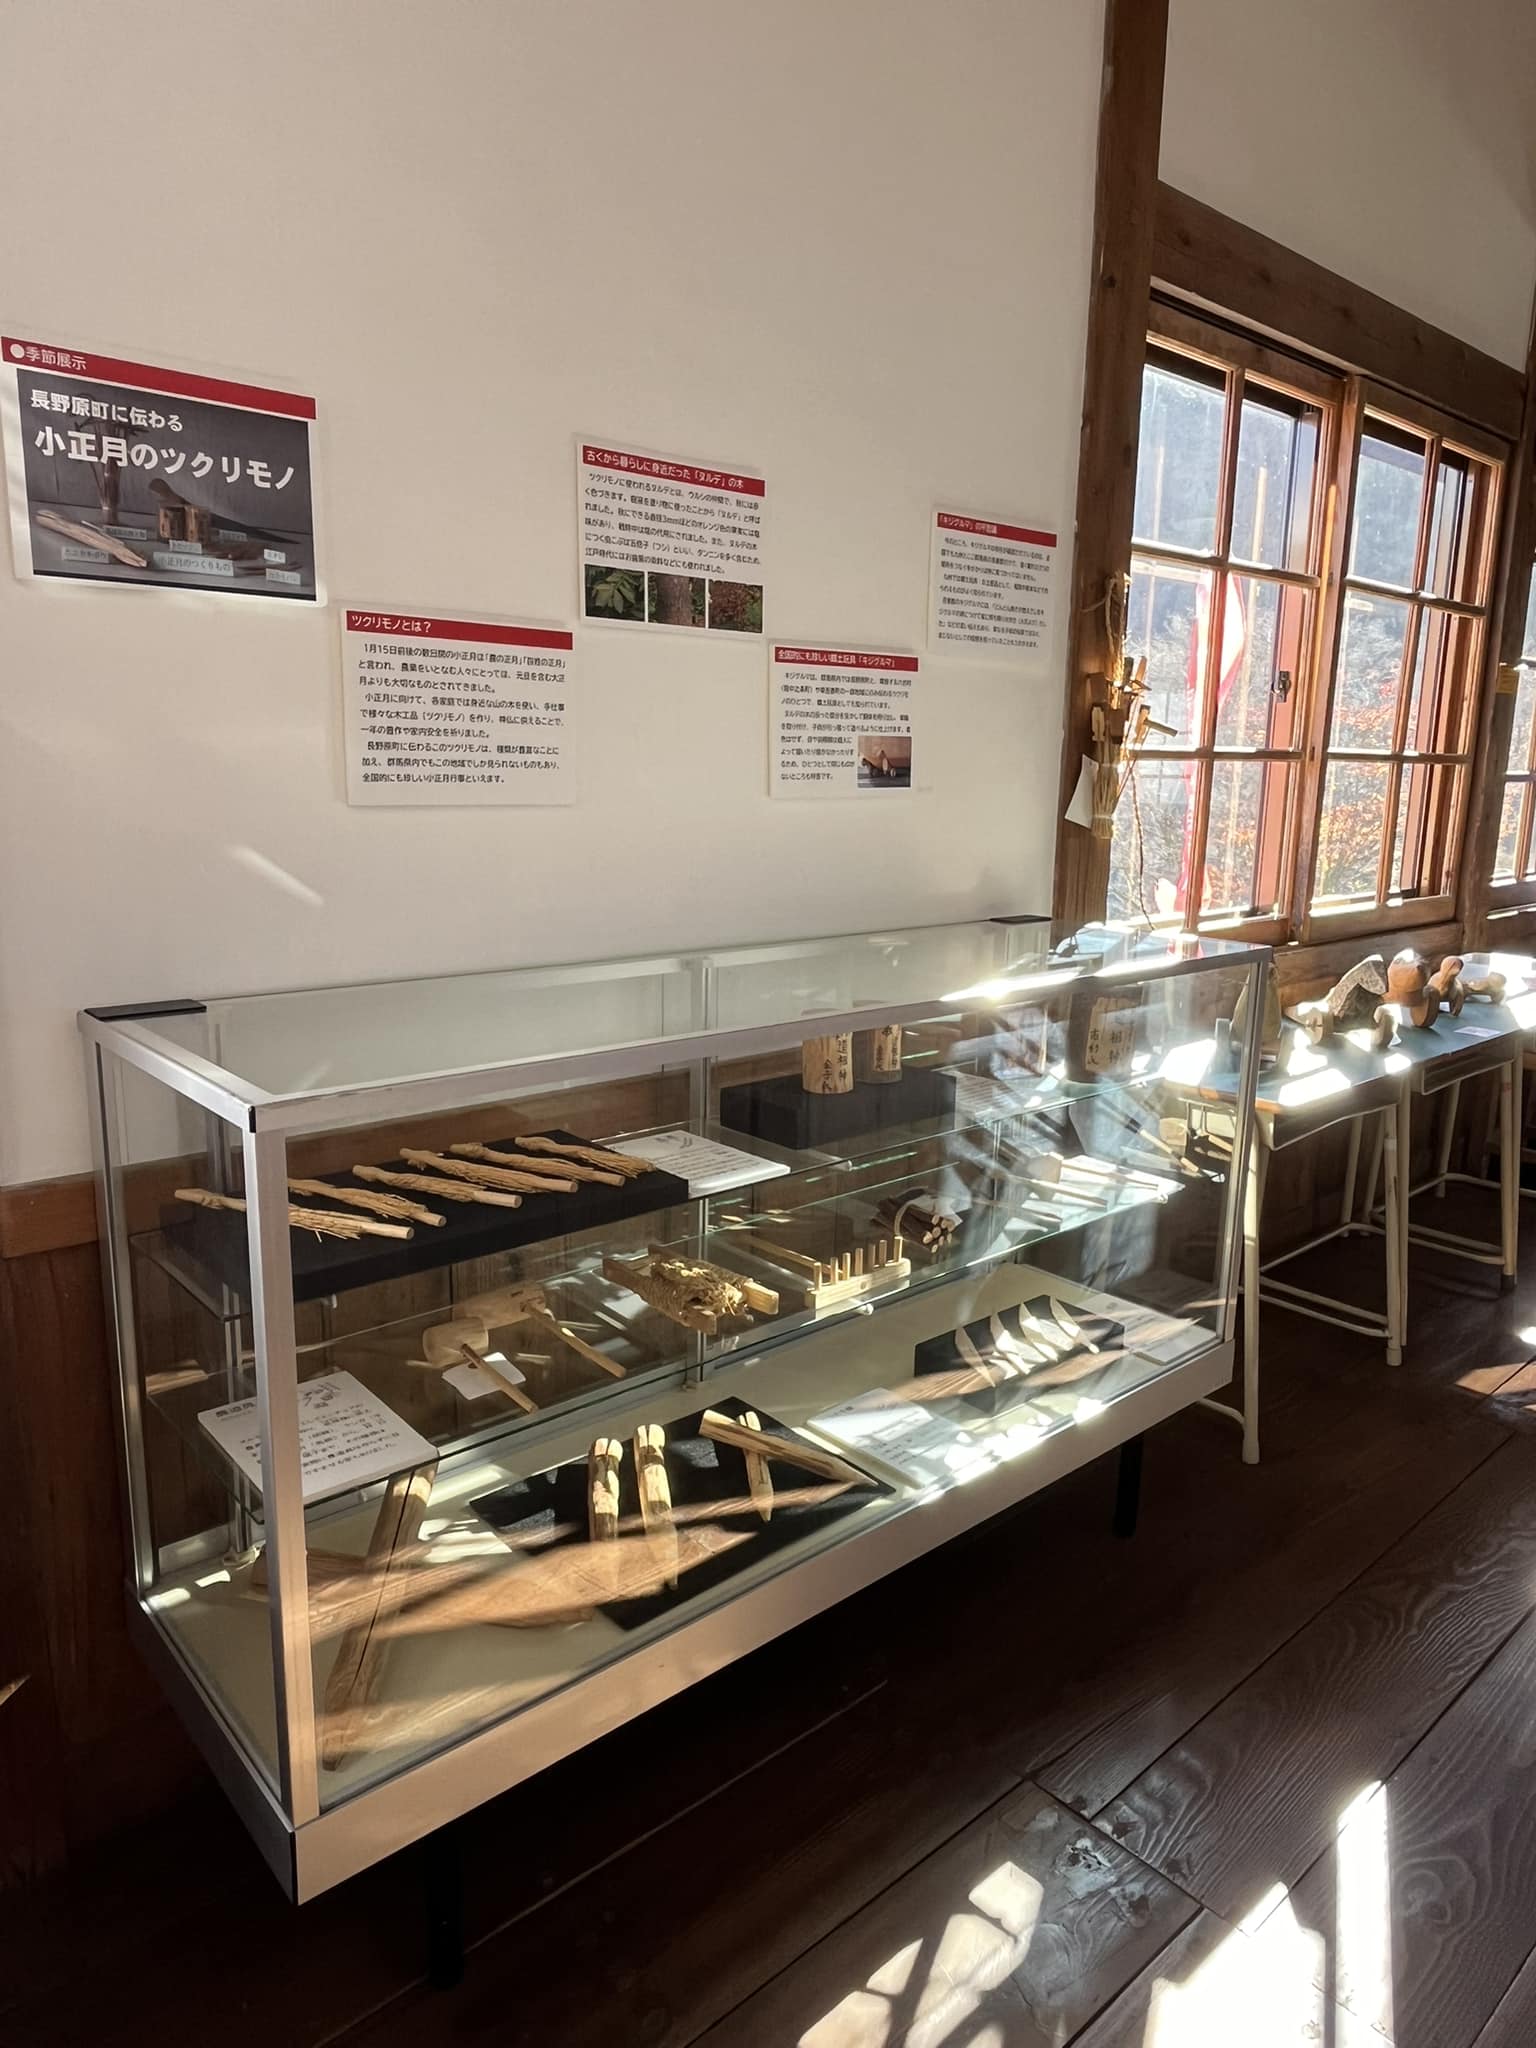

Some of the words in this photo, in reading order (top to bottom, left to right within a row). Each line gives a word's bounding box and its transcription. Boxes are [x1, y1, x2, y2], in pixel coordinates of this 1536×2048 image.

[25, 346, 87, 371] 季節展示
[30, 389, 184, 432] 長野原町に伝わる
[34, 426, 295, 490] 小正月のツクリモノ
[351, 616, 431, 633] ツクリモノとは？
[359, 676, 496, 693] 月よりも大切なものとされてきました。
